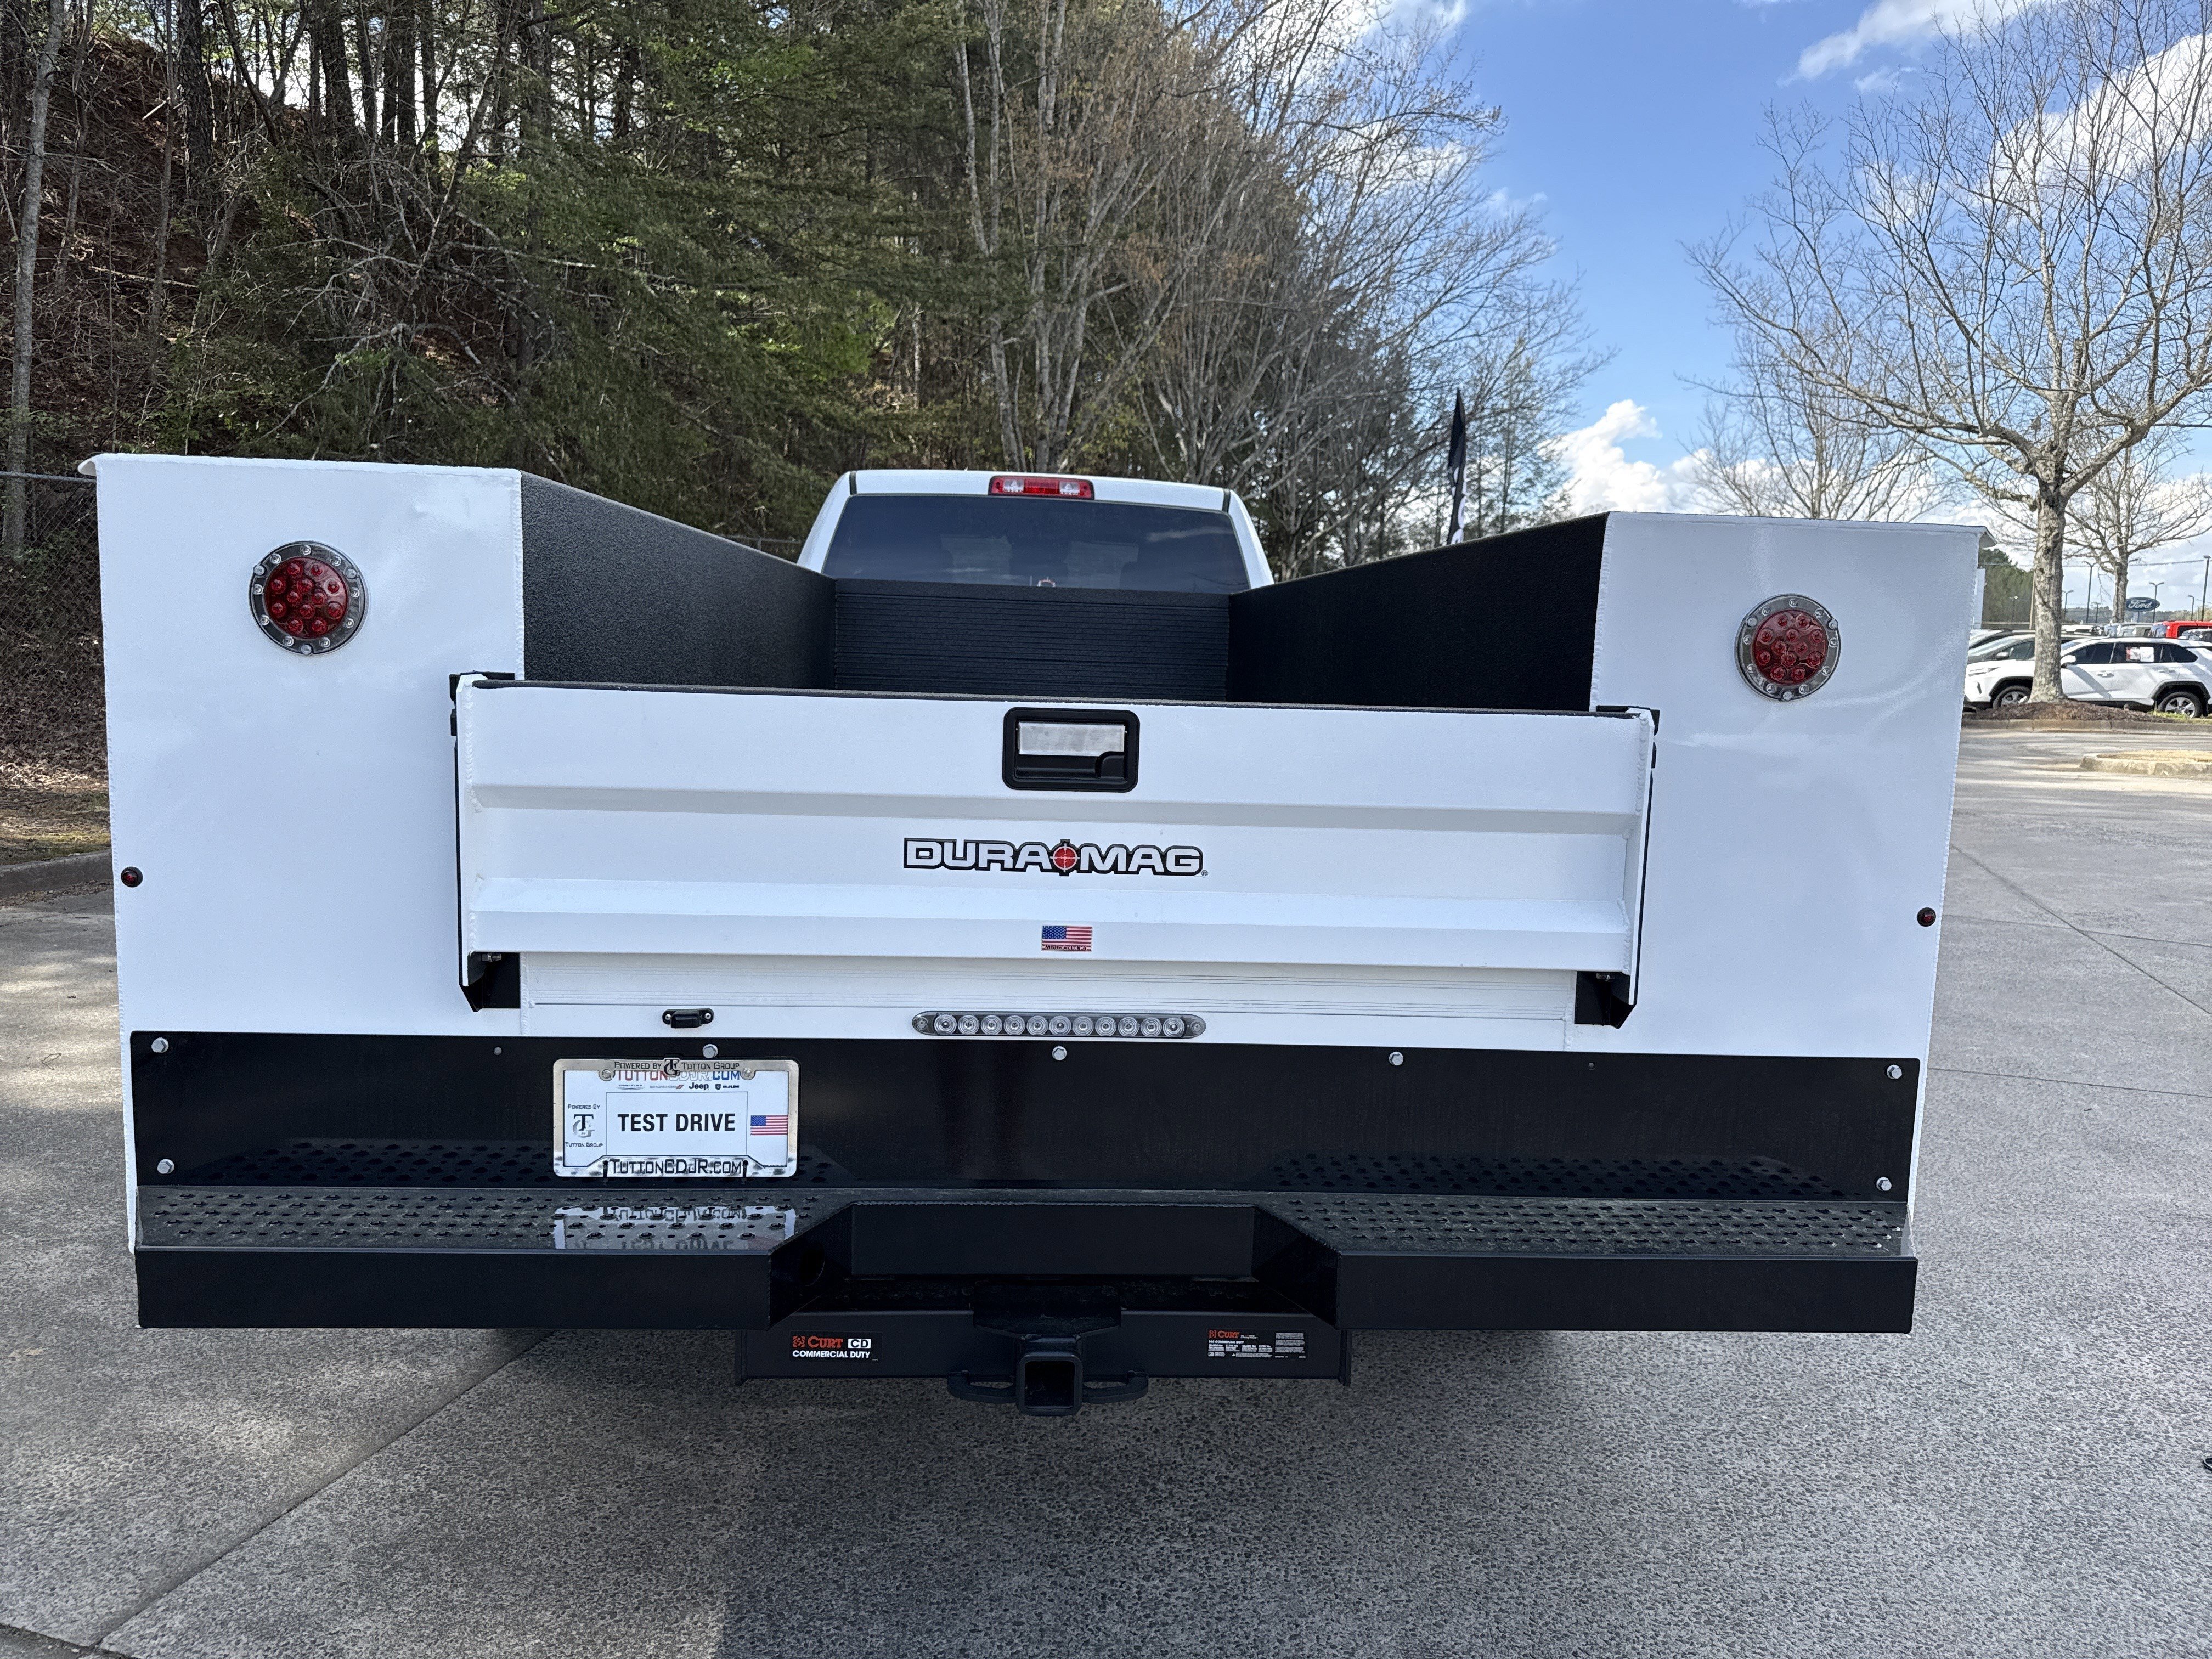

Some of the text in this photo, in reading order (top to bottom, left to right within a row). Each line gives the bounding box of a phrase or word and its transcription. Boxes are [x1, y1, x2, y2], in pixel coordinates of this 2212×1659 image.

[2128, 600, 2152, 609] Ford
[614, 1061, 650, 1069] POWERED
[617, 1113, 735, 1131] TEST DRIVE
[808, 1336, 869, 1348] CURT CD
[792, 1350, 849, 1358] COMMERCIAL
